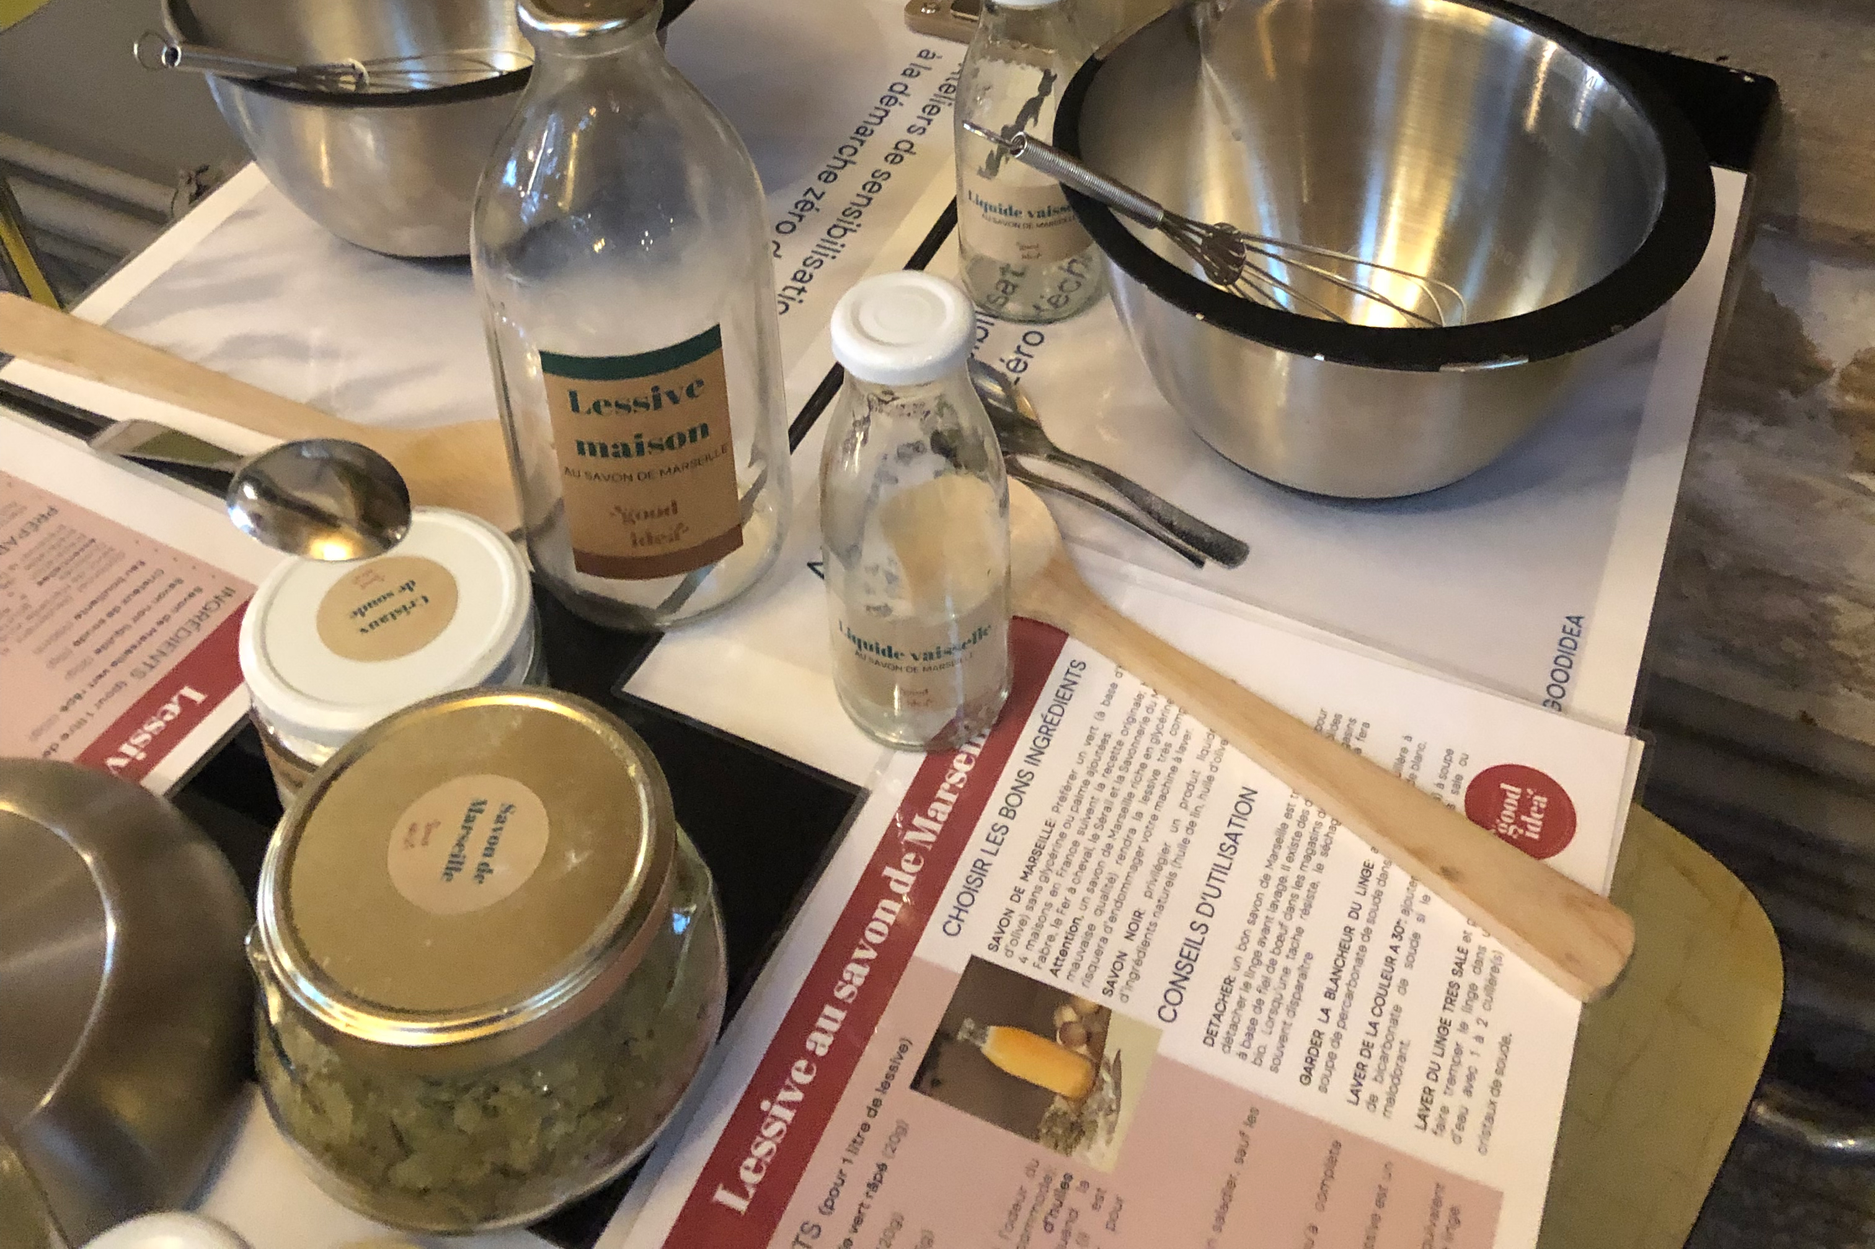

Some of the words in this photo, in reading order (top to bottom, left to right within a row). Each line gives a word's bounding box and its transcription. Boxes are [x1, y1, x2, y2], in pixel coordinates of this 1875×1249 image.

[899, 59, 929, 84] la
[915, 46, 941, 65] à
[905, 62, 963, 136] teliers
[816, 81, 911, 184] démarche
[882, 135, 918, 170] de
[774, 186, 826, 235] zéro
[990, 319, 1045, 386] éro
[566, 378, 704, 416] Lessive
[574, 422, 709, 458] maison
[563, 465, 581, 479] AU
[583, 467, 633, 486] SAVON
[636, 470, 652, 481] DE
[658, 441, 728, 477] MARSEILLE
[129, 585, 236, 679] INGRÉDIENTS
[838, 619, 905, 661] Liquide
[1542, 615, 1585, 712] GOODIDEA
[1099, 681, 1118, 707] base
[1144, 700, 1158, 715] du
[1093, 710, 1106, 721] (à
[1083, 724, 1099, 746] vert
[1117, 715, 1151, 773] Savonnerie
[1075, 750, 1086, 765] un
[1100, 738, 1124, 778] recette
[1142, 745, 1154, 760] en
[1050, 768, 1077, 814] Préférer
[1093, 781, 1106, 792] la
[1108, 785, 1120, 798] et
[1112, 774, 1126, 785] la
[1130, 761, 1148, 789] riche
[941, 857, 992, 937] CHOISIR
[979, 821, 1009, 857] LES
[997, 768, 1035, 820] BONS
[1023, 658, 1086, 767] INGRÉDIENTS
[1092, 798, 1114, 831] Sérail
[1283, 801, 1296, 820] est
[1497, 782, 1523, 839] good
[1521, 788, 1548, 840] idea
[480, 803, 516, 858] Savon
[1075, 794, 1099, 836] suivent
[1106, 790, 1135, 840] Marseille
[1295, 808, 1310, 829] des
[442, 798, 488, 882] Marseille
[1086, 831, 1100, 844] le
[1100, 841, 1114, 858] de
[1264, 821, 1289, 870] Marseille
[1284, 829, 1303, 864] existe
[1298, 820, 1323, 872] magasins
[473, 861, 494, 884] de
[1003, 913, 1031, 958] d'olive)
[1024, 883, 1043, 912] sans
[1037, 830, 1067, 884] glycérine
[1061, 814, 1075, 830] ou
[1069, 778, 1091, 814] palme
[1054, 839, 1080, 878] France
[1070, 846, 1096, 885] cheval,
[1279, 863, 1291, 872] Il
[1048, 882, 1061, 897] en
[1066, 886, 1077, 895] à
[1085, 859, 1105, 894] savon
[1101, 950, 1128, 997] SAVON
[1142, 841, 1171, 899] privilégier
[1169, 817, 1181, 833] un
[1178, 768, 1201, 811] produit
[1258, 872, 1272, 889] de
[1290, 873, 1306, 891] les
[1008, 885, 1025, 903] DE
[1055, 895, 1071, 916] Fer
[1078, 895, 1091, 911] un
[1157, 919, 1209, 1023] CONSEILS
[1194, 785, 1258, 918] D'UTILISATION
[1246, 891, 1264, 926] savon
[1282, 891, 1300, 921] dans
[1346, 900, 1362, 920] DU
[987, 907, 1015, 952] SAVON
[1024, 900, 1053, 951] maisons
[1049, 916, 1063, 929] le
[1256, 914, 1274, 948] avant
[1268, 920, 1288, 956] bœuf
[1031, 932, 1058, 970] Fabre,
[1048, 915, 1084, 978] Attention,
[1235, 928, 1251, 952] bon
[1388, 944, 1400, 954] A
[1017, 955, 1029, 964] 4
[1231, 954, 1242, 971] un
[1243, 948, 1263, 979] linge
[1264, 956, 1278, 975] de
[1322, 924, 1355, 1001] BLANCHEUR
[1450, 945, 1469, 978] SALE
[1238, 980, 1252, 993] le
[1255, 974, 1271, 995] fiel
[1370, 954, 1397, 1018] COULEUR
[1441, 980, 1461, 1012] TRES
[1201, 974, 1236, 1047] DETACHER:
[1251, 996, 1265, 1015] de
[1317, 1007, 1331, 1024] LA
[712, 1057, 816, 1215] Lessive
[802, 1002, 847, 1064] au
[830, 898, 903, 1003] savon
[881, 849, 926, 903] de
[1220, 993, 1247, 1054] détacher
[1239, 1016, 1259, 1049] base
[1365, 1020, 1380, 1037] LA
[1432, 1016, 1452, 1058] LINGE
[874, 1037, 913, 1095] lessive)
[1235, 1050, 1248, 1061] à
[1298, 1028, 1325, 1086] GARDER
[1358, 1039, 1375, 1060] DE
[1346, 1060, 1368, 1106] LAVER
[1425, 1059, 1441, 1083] DU
[865, 1097, 882, 1118] de
[1414, 1085, 1435, 1131] LAVER
[846, 1121, 871, 1155] litre
[840, 1155, 854, 1167] 1
[817, 1167, 846, 1215] (pour
[848, 1200, 870, 1234] vert
[864, 1161, 888, 1198] râpé
